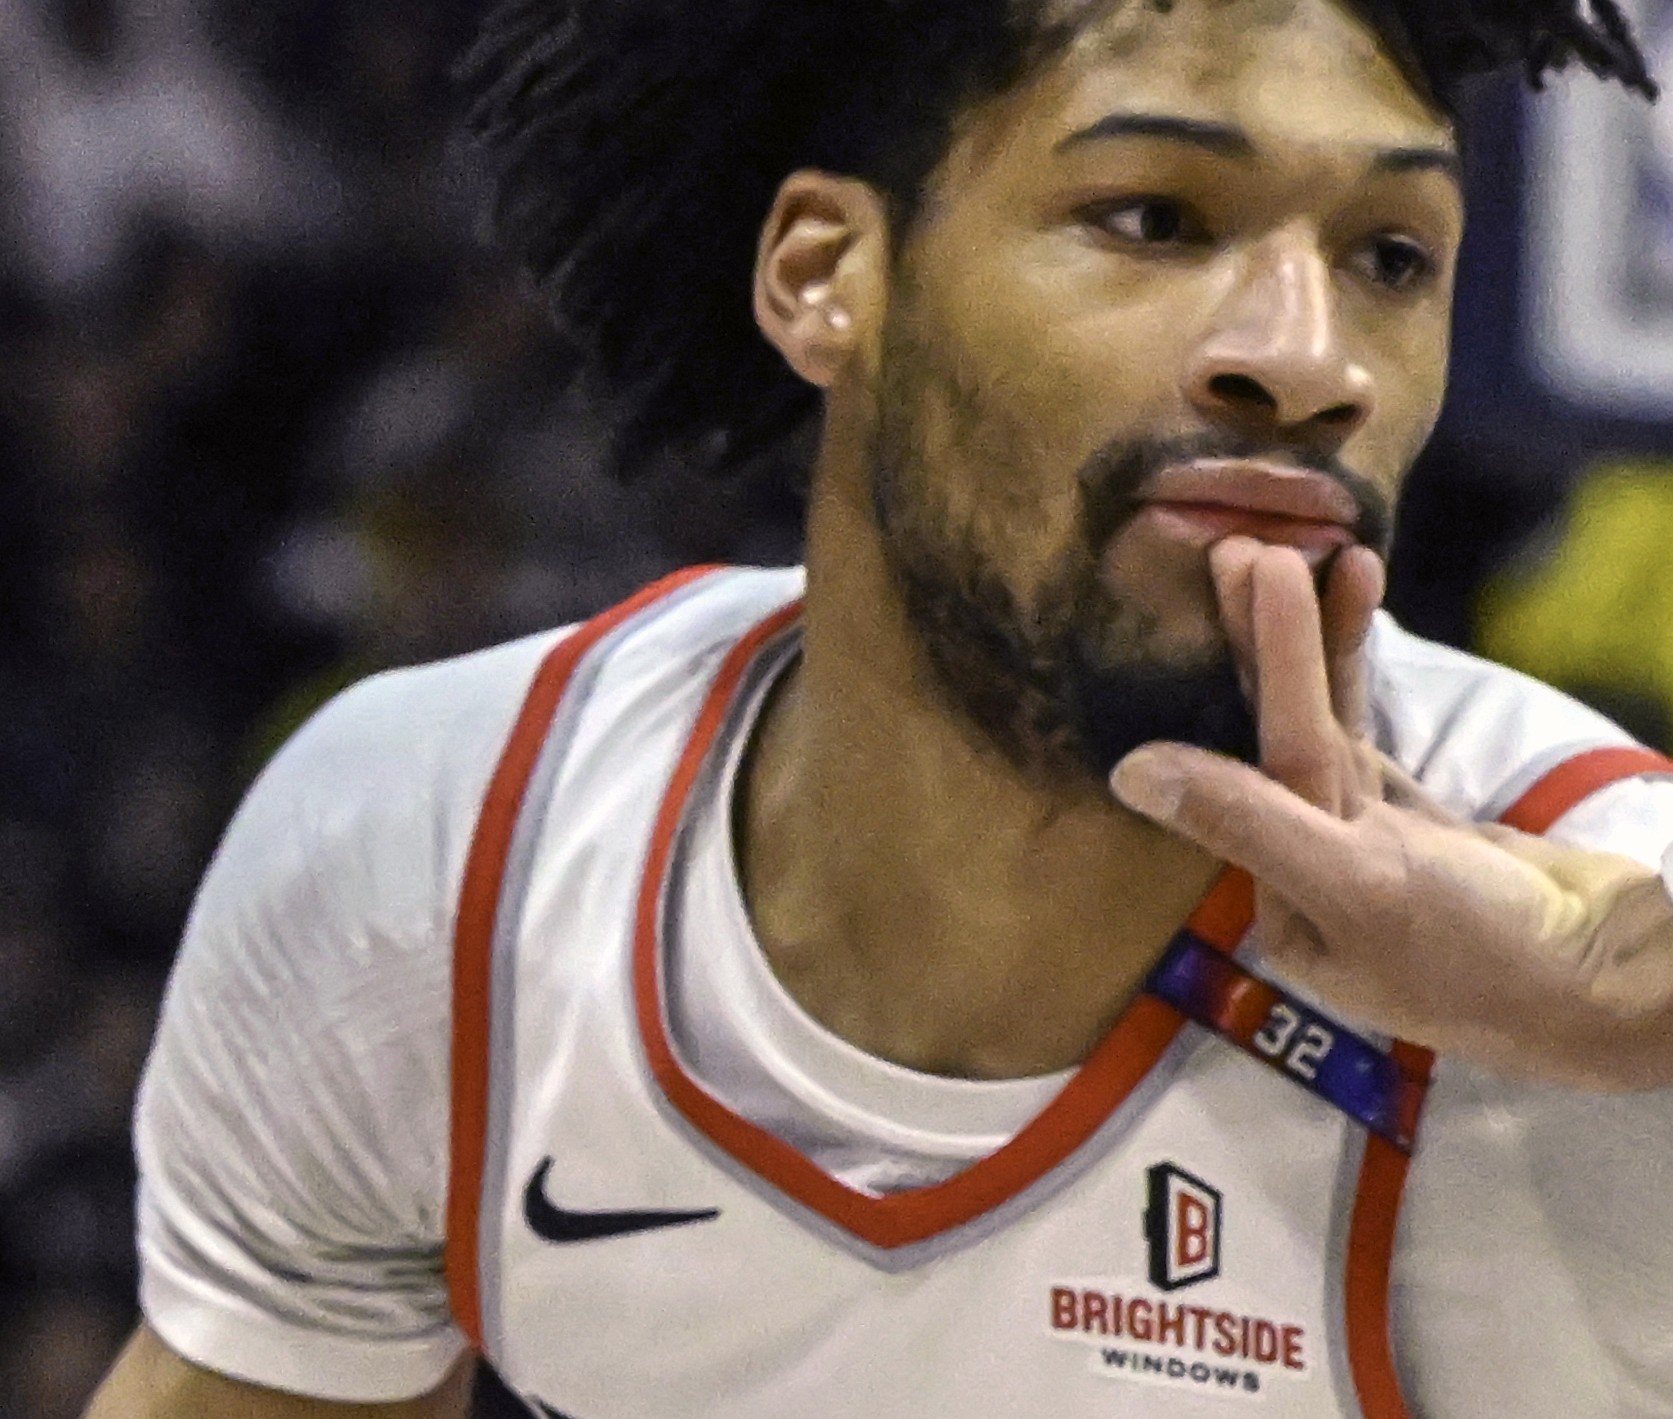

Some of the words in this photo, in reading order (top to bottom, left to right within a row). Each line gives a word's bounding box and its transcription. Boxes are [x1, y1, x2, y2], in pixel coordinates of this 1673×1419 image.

[1252, 1001, 1336, 1081] 32
[1050, 1286, 1306, 1370] BRIGHTSIDE
[1101, 1346, 1261, 1393] WINDOWS
